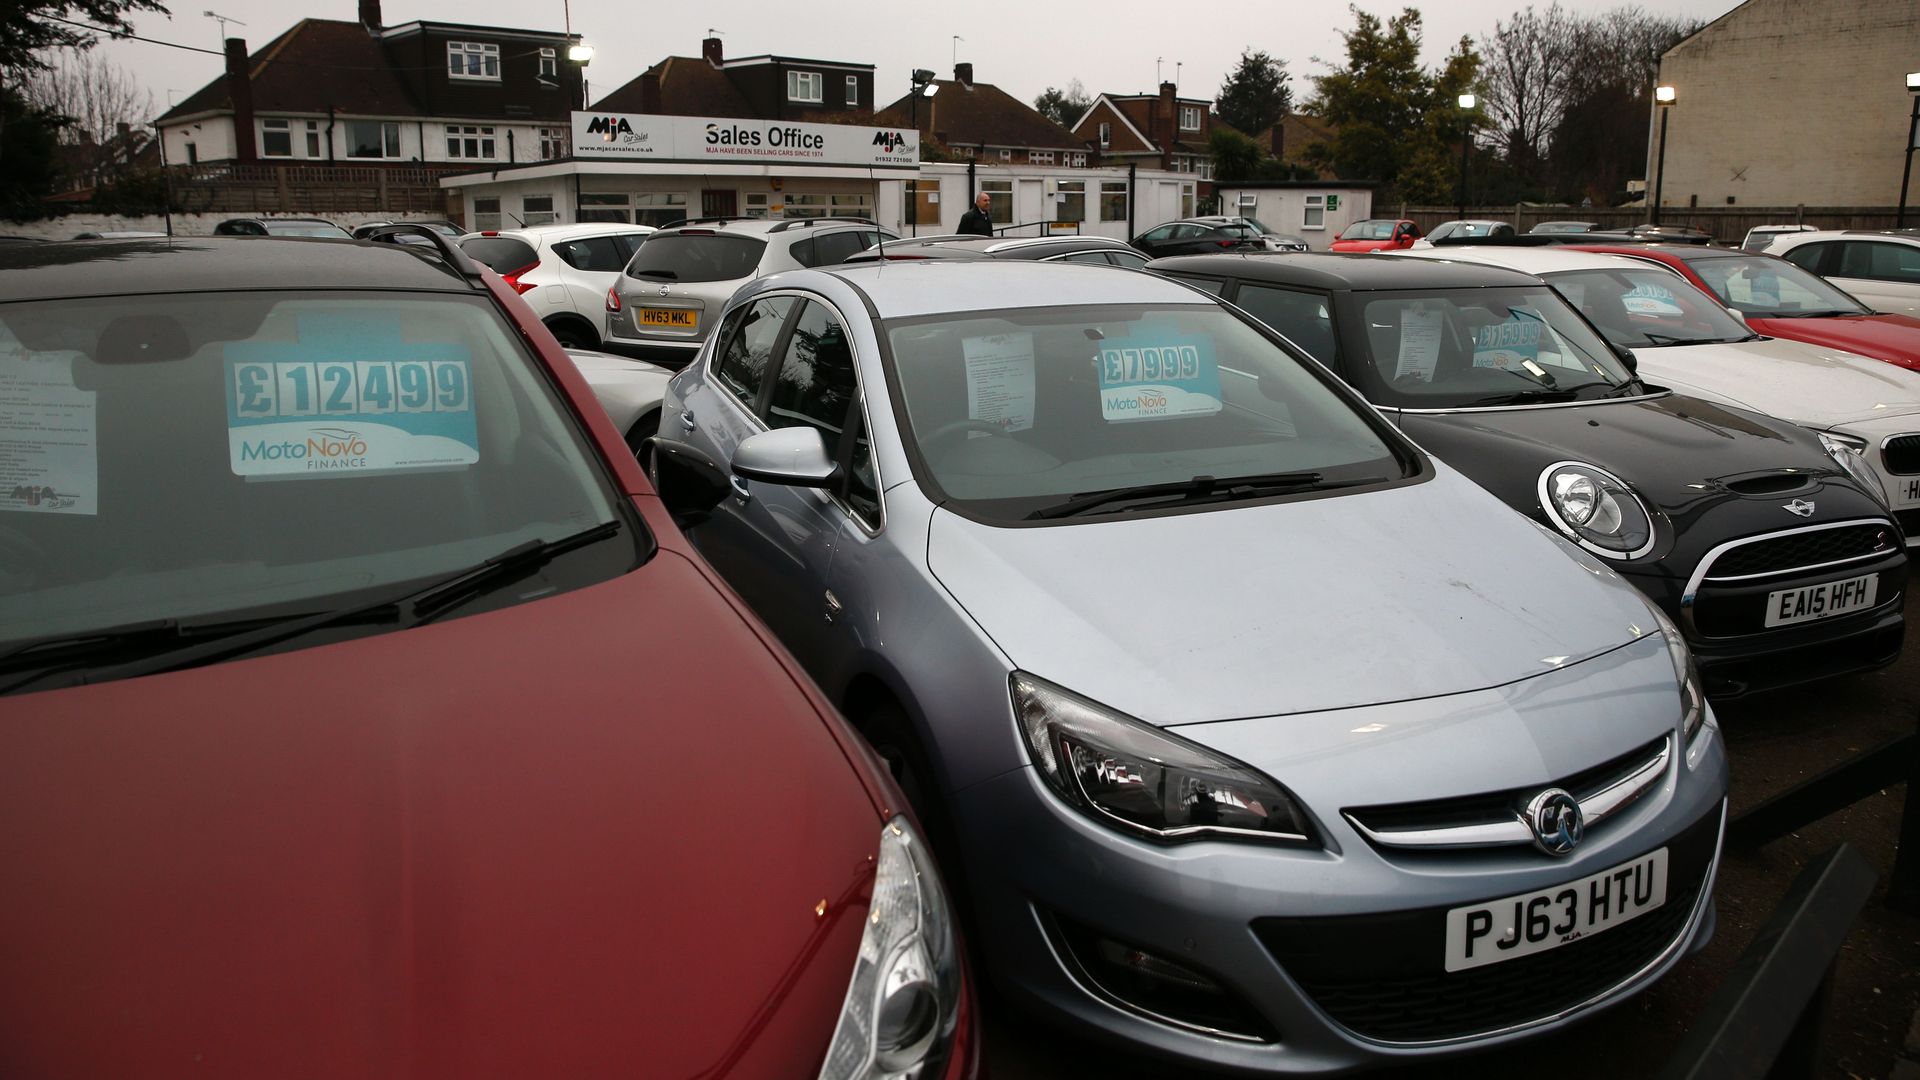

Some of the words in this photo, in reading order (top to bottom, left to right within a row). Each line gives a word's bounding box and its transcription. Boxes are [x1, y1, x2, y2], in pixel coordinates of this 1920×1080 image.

[634, 132, 649, 142] Sales
[705, 123, 761, 145] Sales
[767, 126, 824, 149] Office
[579, 145, 654, 153] www.mjacarsales.co.uk
[719, 147, 736, 155] HAVE
[753, 148, 777, 156] SELLING
[778, 149, 793, 157] CARS
[643, 309, 670, 325] HV63
[671, 309, 691, 325] MKL
[1103, 346, 1199, 383] £7999
[239, 362, 465, 413] £12499
[1107, 395, 1167, 411] MotoNovo
[1138, 407, 1167, 416] FINANCE
[241, 435, 367, 461] MotoNovo
[307, 458, 367, 470] FINANCE
[1779, 585, 1826, 620] EA15
[1830, 578, 1866, 610] HFH
[1464, 888, 1578, 959] PJ63
[1589, 859, 1655, 926] HTU
